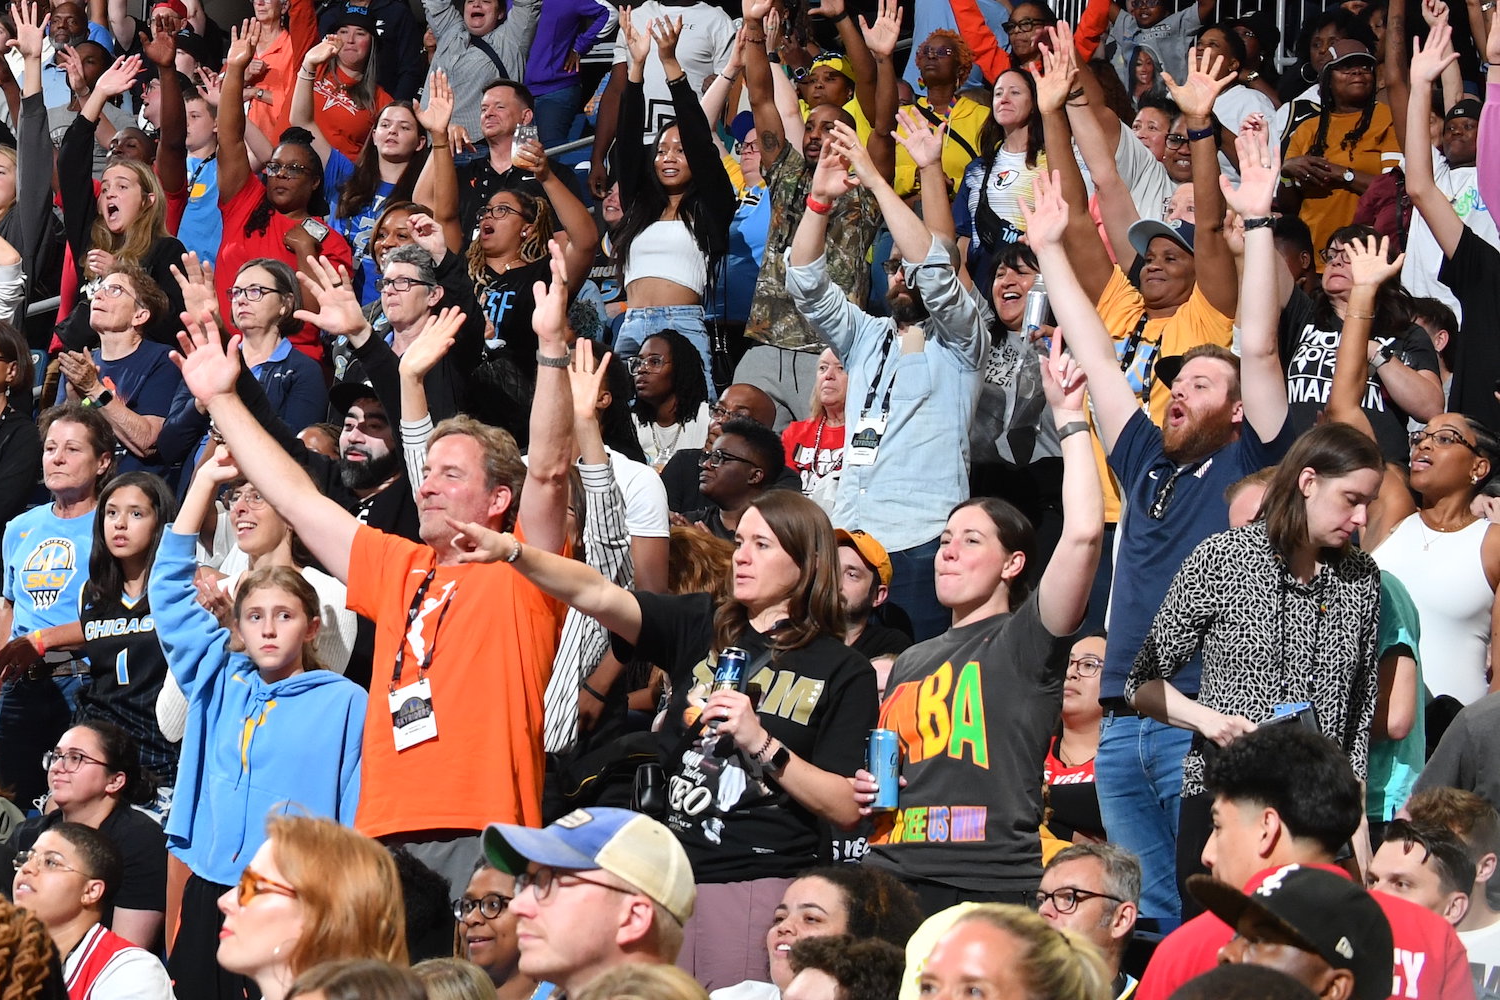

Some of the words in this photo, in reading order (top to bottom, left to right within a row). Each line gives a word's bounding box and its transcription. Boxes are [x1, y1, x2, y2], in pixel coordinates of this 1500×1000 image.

[24, 571, 67, 589] SKY
[116, 648, 134, 685] 1
[714, 666, 741, 681] Cold
[928, 806, 949, 841] US
[950, 806, 987, 841] WIN!
